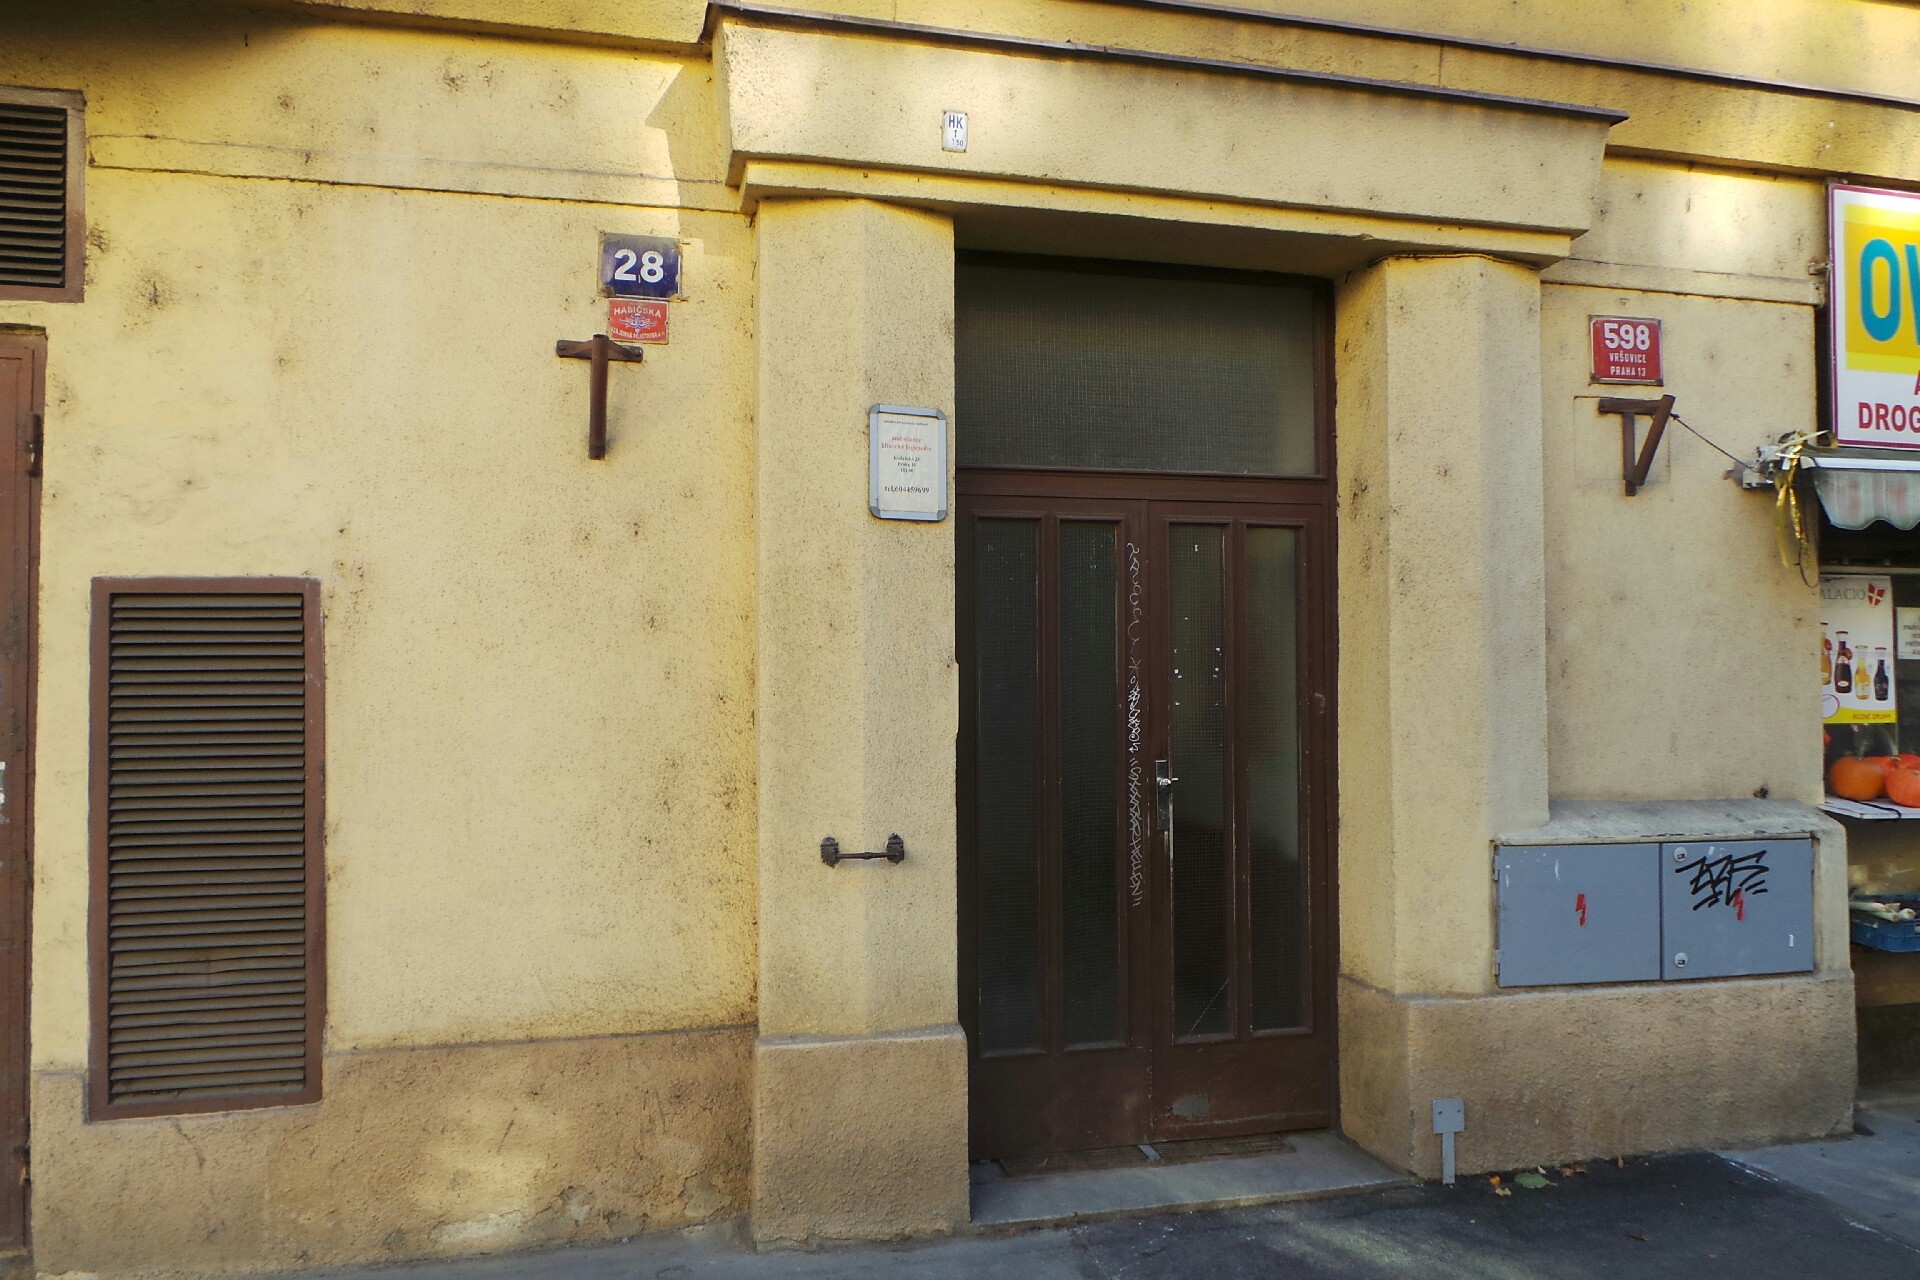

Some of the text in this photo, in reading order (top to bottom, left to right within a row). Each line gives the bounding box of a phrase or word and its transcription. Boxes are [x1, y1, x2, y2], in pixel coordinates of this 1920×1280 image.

[949, 115, 963, 129] HK
[614, 249, 664, 283] 28
[1604, 323, 1650, 350] 598
[1609, 351, 1647, 363] VRŠOVICE
[1610, 366, 1646, 377] PRAHA 13
